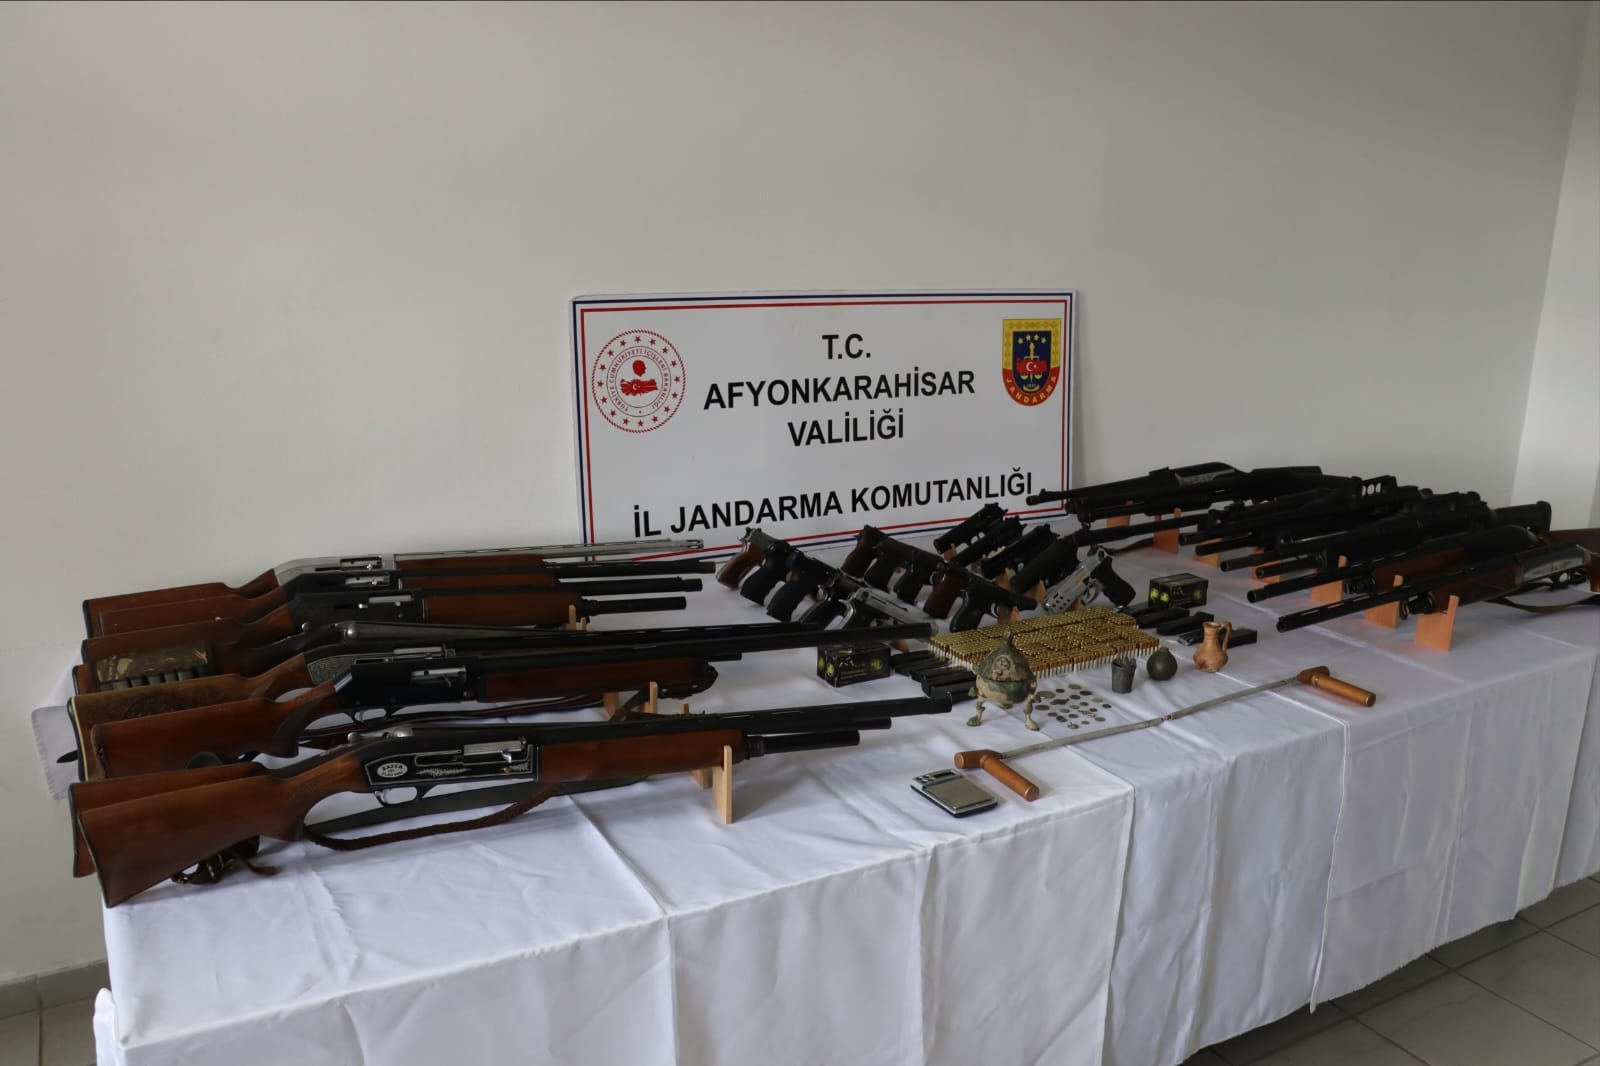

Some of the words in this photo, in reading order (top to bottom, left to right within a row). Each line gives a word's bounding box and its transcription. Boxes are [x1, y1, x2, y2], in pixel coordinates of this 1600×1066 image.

[821, 334, 871, 360] T.C.
[703, 366, 976, 410] AFYONKARAHİSAR
[1006, 376, 1057, 403] JANDARMA
[787, 407, 904, 447] VALİLİĞİ
[633, 504, 662, 538] İL
[670, 490, 844, 534] JANDARMA
[851, 466, 1032, 513] KOMUTANLIĞI
